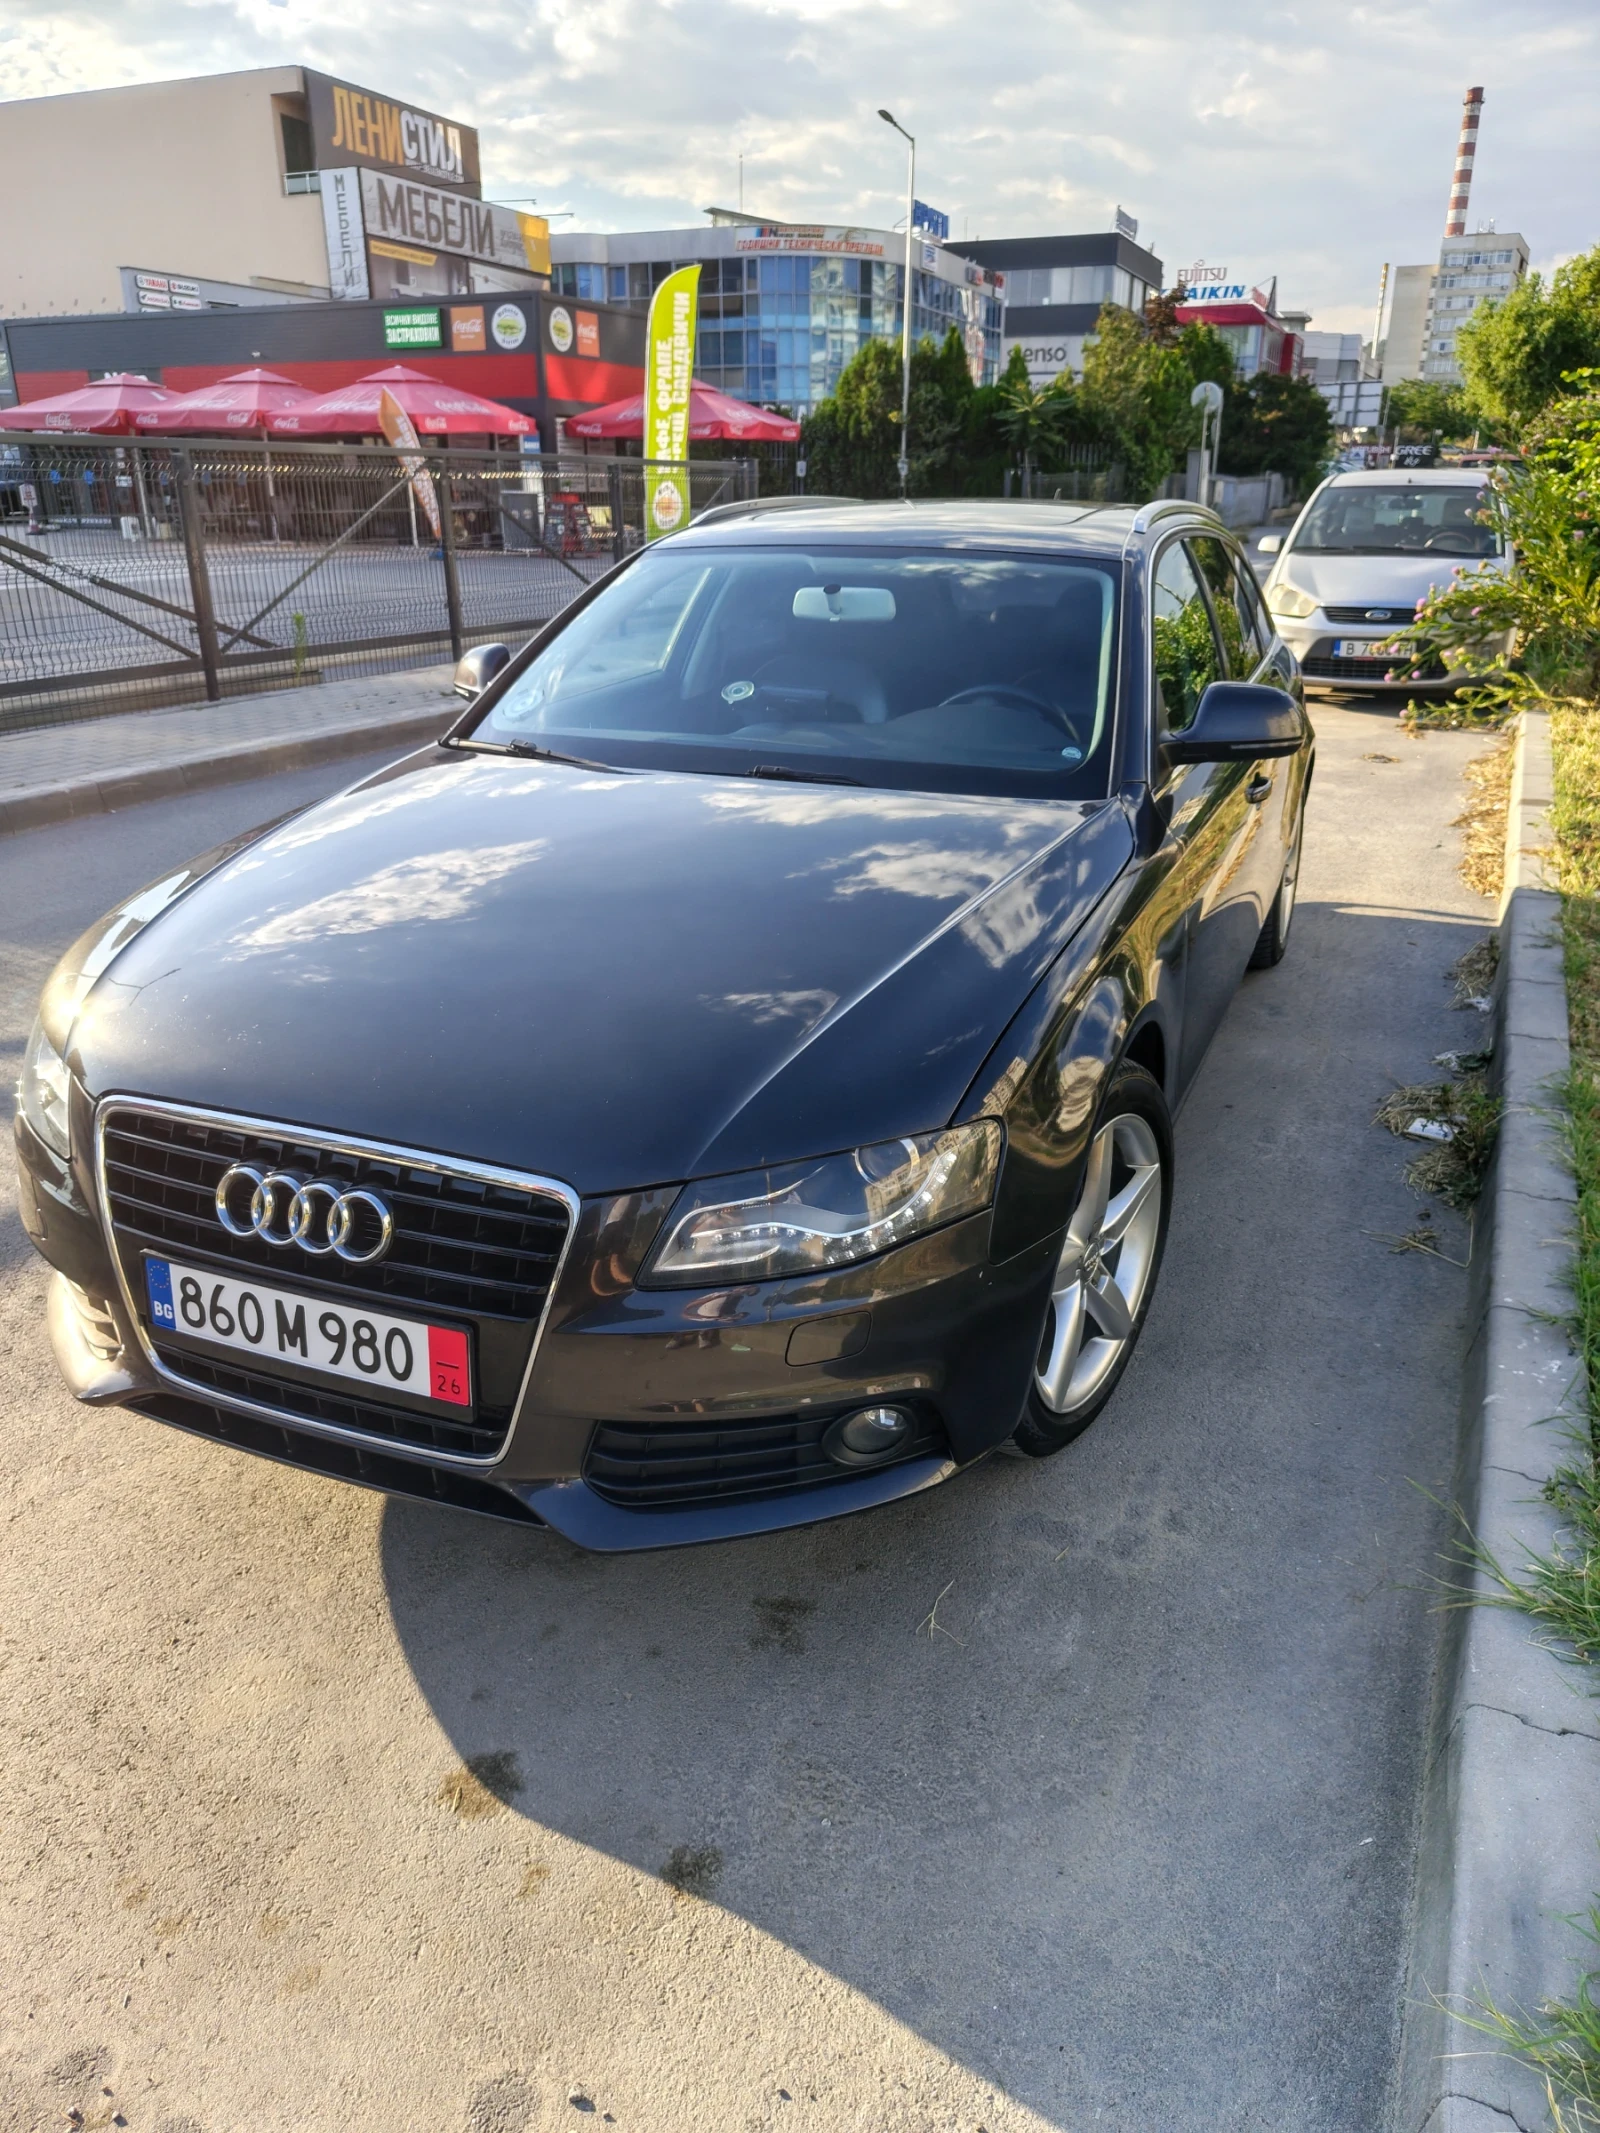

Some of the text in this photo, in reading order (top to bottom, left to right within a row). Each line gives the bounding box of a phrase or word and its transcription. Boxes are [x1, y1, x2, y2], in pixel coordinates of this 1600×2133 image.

[332, 86, 464, 175] ЛЕНИСТИЛ
[377, 178, 496, 257] МЕБЕЛИ
[333, 174, 362, 288] МЕБЕЛИ
[1177, 267, 1228, 284] FUJITSU
[1182, 285, 1246, 300] AIKIN
[1007, 346, 1067, 363] senso
[1395, 444, 1433, 456] GREE
[153, 1300, 173, 1320] BG
[179, 1276, 413, 1382] 860 M 980
[437, 1374, 461, 1395] 26
